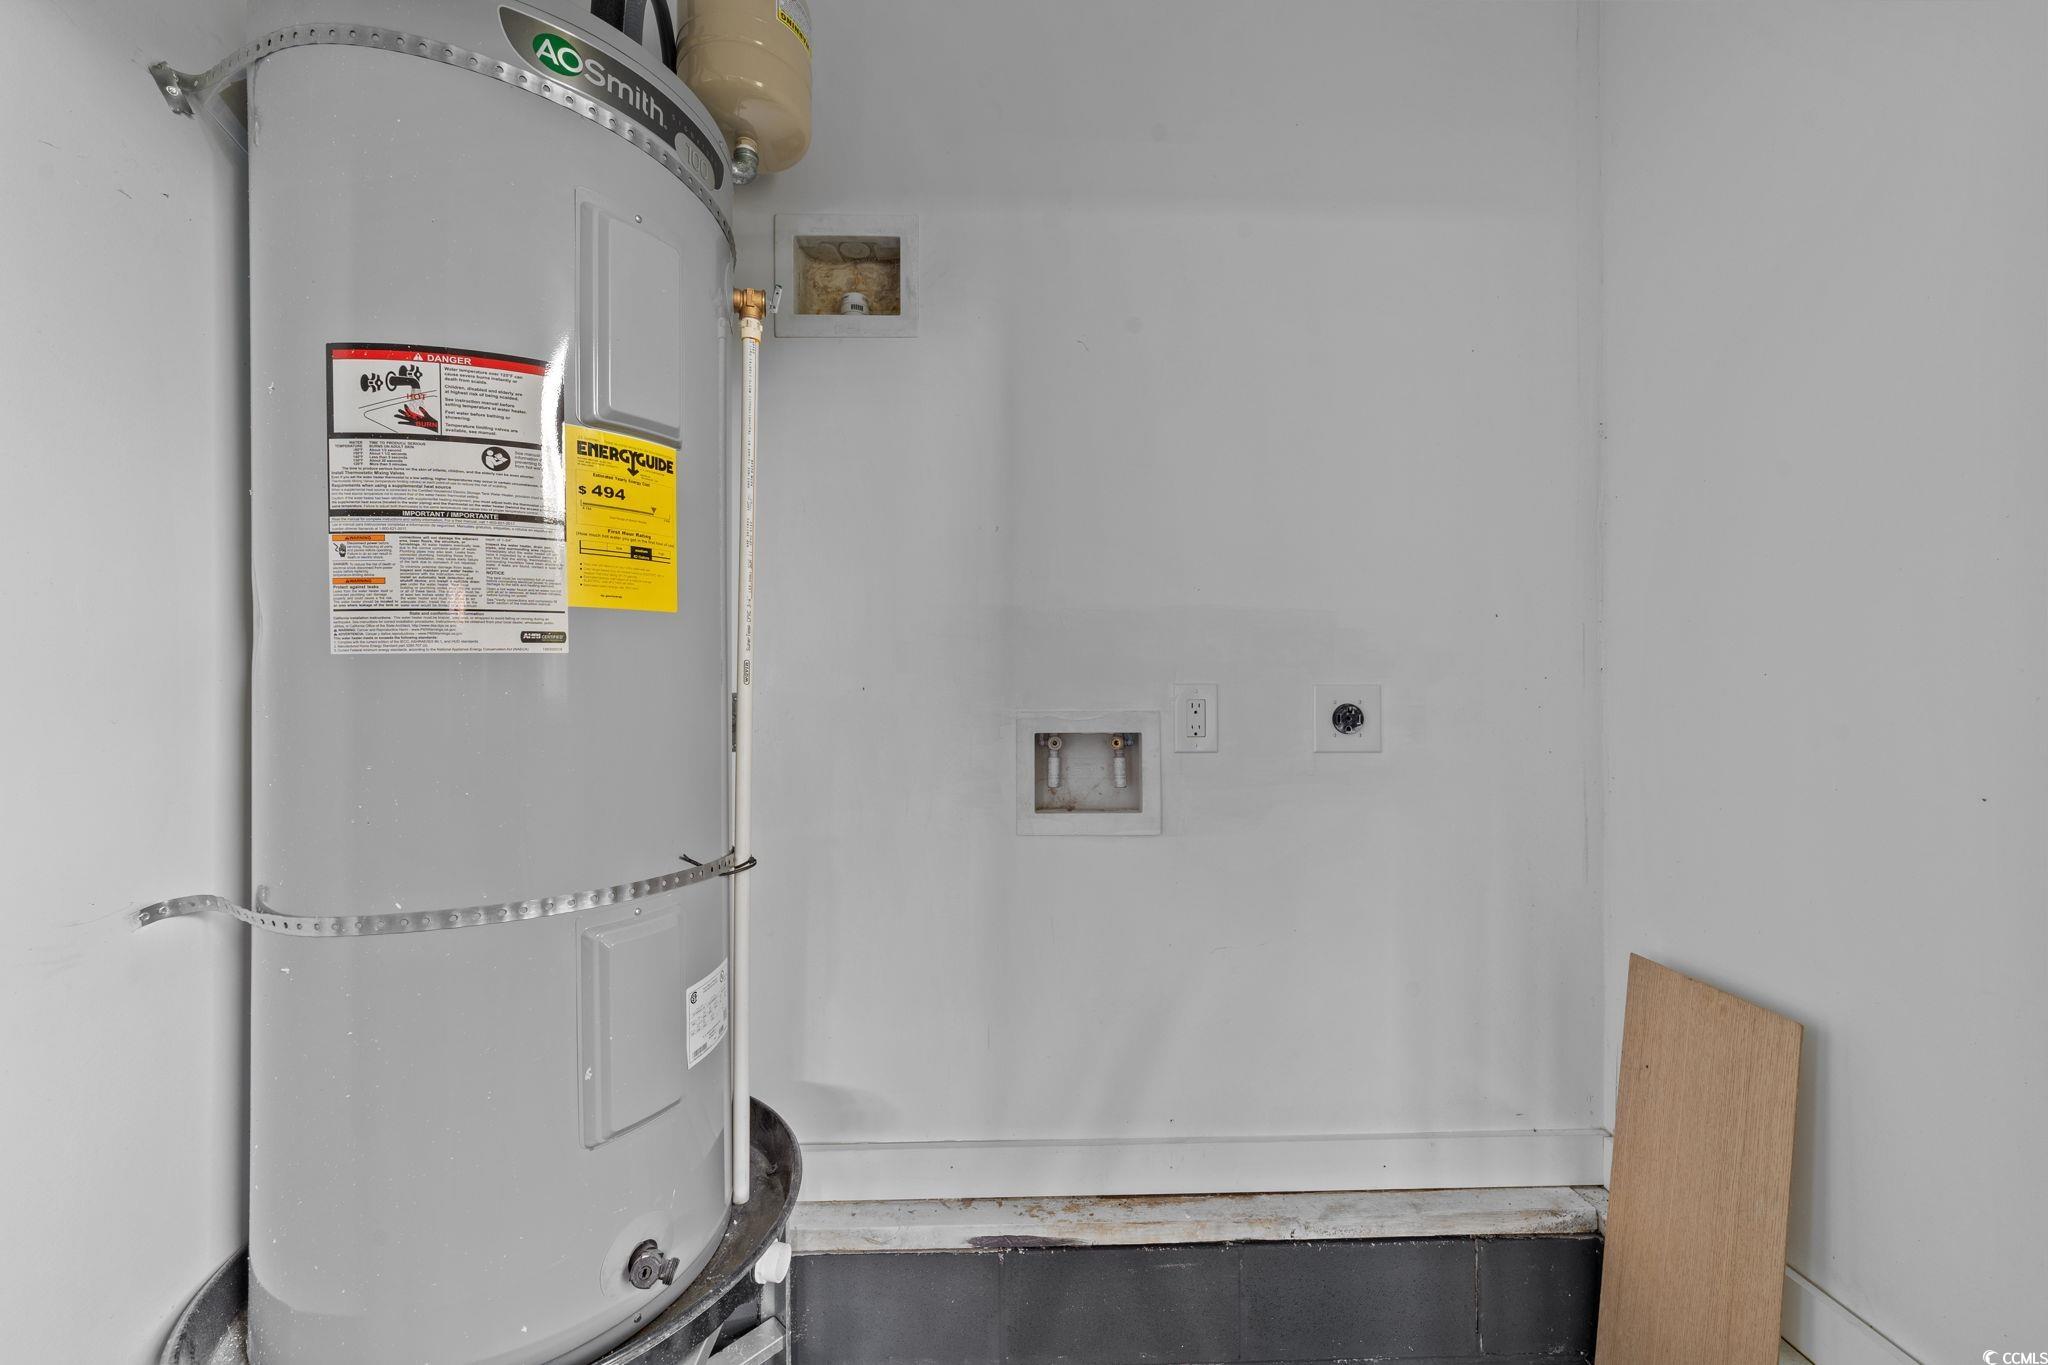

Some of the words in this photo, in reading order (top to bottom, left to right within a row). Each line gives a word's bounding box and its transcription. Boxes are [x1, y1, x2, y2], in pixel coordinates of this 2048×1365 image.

[427, 354, 472, 366] DANGER
[576, 440, 674, 477] ENERGYGUIDE
[593, 472, 614, 481] Estimated
[614, 476, 628, 484] Yearly
[628, 479, 642, 487] Energy
[578, 485, 587, 496] $
[591, 484, 626, 501] 494
[402, 510, 446, 518] IMPORTANT
[450, 511, 500, 521] IMPORTANTE
[607, 528, 621, 536] First
[621, 530, 635, 538] Hour
[635, 532, 652, 541] Rating
